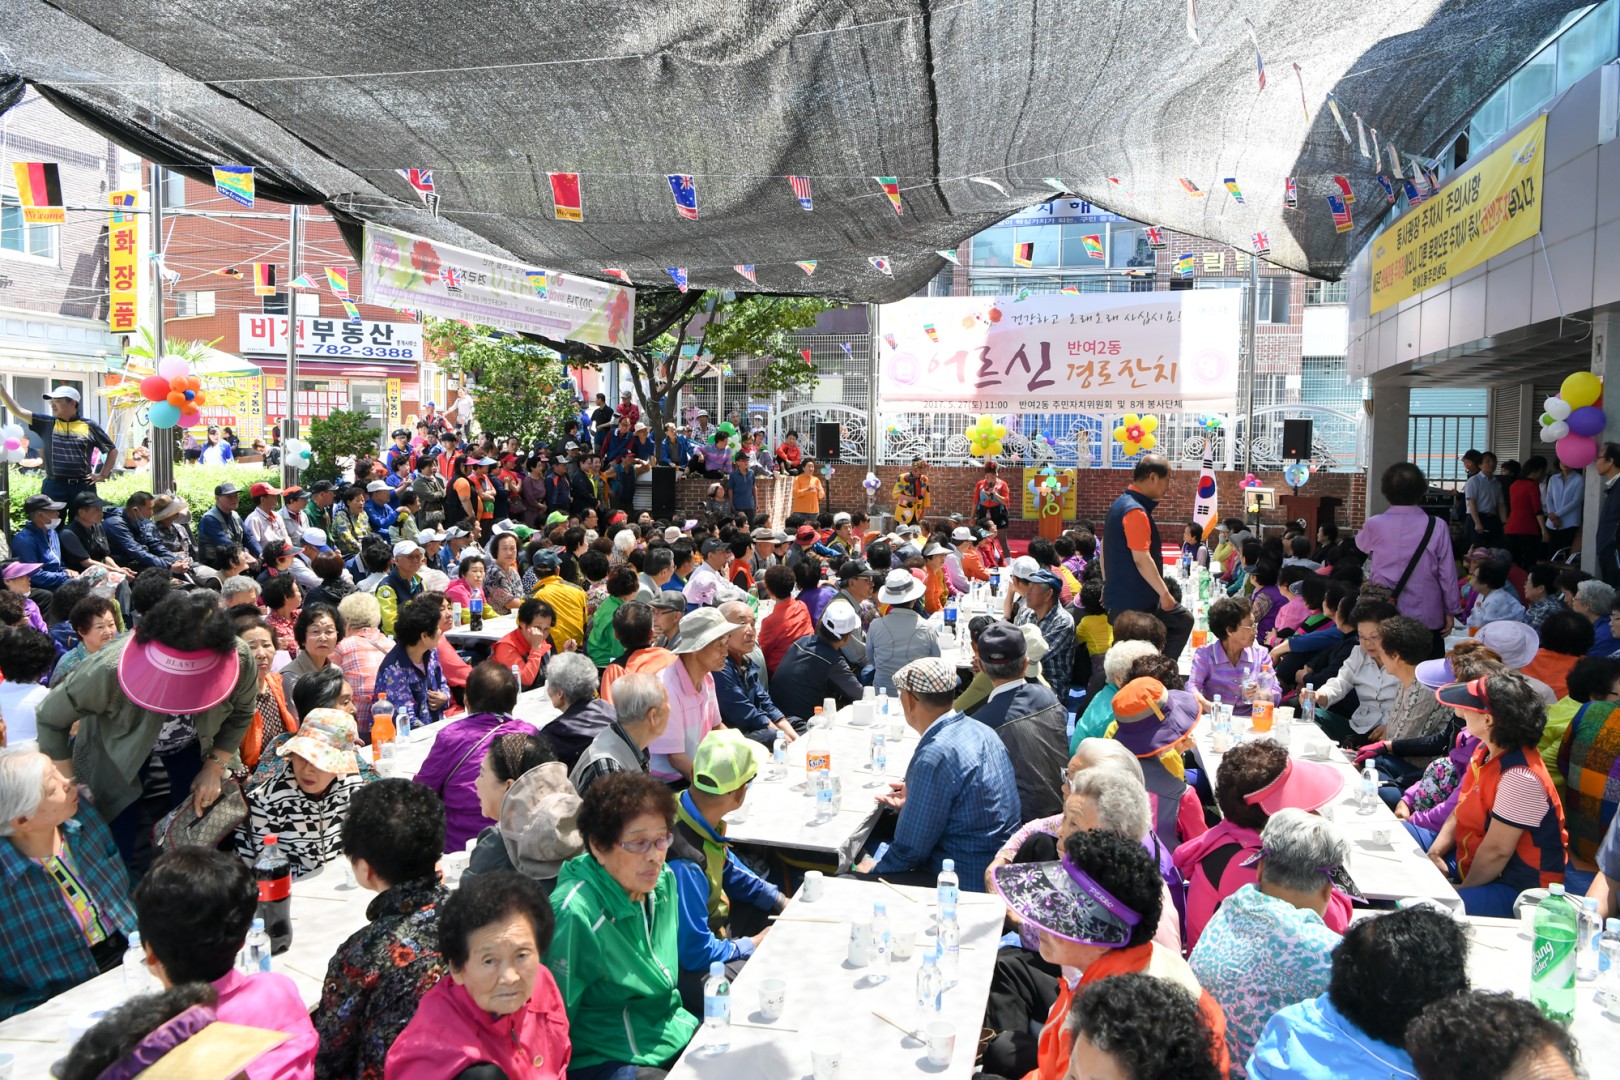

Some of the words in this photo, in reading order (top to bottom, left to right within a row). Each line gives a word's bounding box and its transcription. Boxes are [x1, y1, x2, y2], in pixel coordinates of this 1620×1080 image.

[219, 187, 252, 207] Welcome
[1422, 198, 1443, 233] 주차시
[1446, 173, 1481, 218] 주의사항
[25, 208, 64, 220] Welcome
[113, 229, 136, 328] 화장품
[1011, 313, 1060, 325] 건강하고
[1069, 312, 1119, 325] 오래오래
[312, 319, 394, 345] 부동산
[312, 344, 413, 359] 782-3388
[1067, 340, 1122, 356] 반여2동
[927, 341, 1056, 392] 어르신
[1066, 355, 1178, 389] 경로잔치
[985, 401, 1008, 409] 11:00
[1019, 401, 1049, 410] 반여2동
[1052, 400, 1113, 410] 주민자치위원회
[1117, 400, 1126, 410] 및
[1130, 400, 1145, 409] 8개
[1147, 399, 1183, 409] 봉사단체
[165, 658, 196, 668] BLAST
[1533, 957, 1549, 976] Cider
